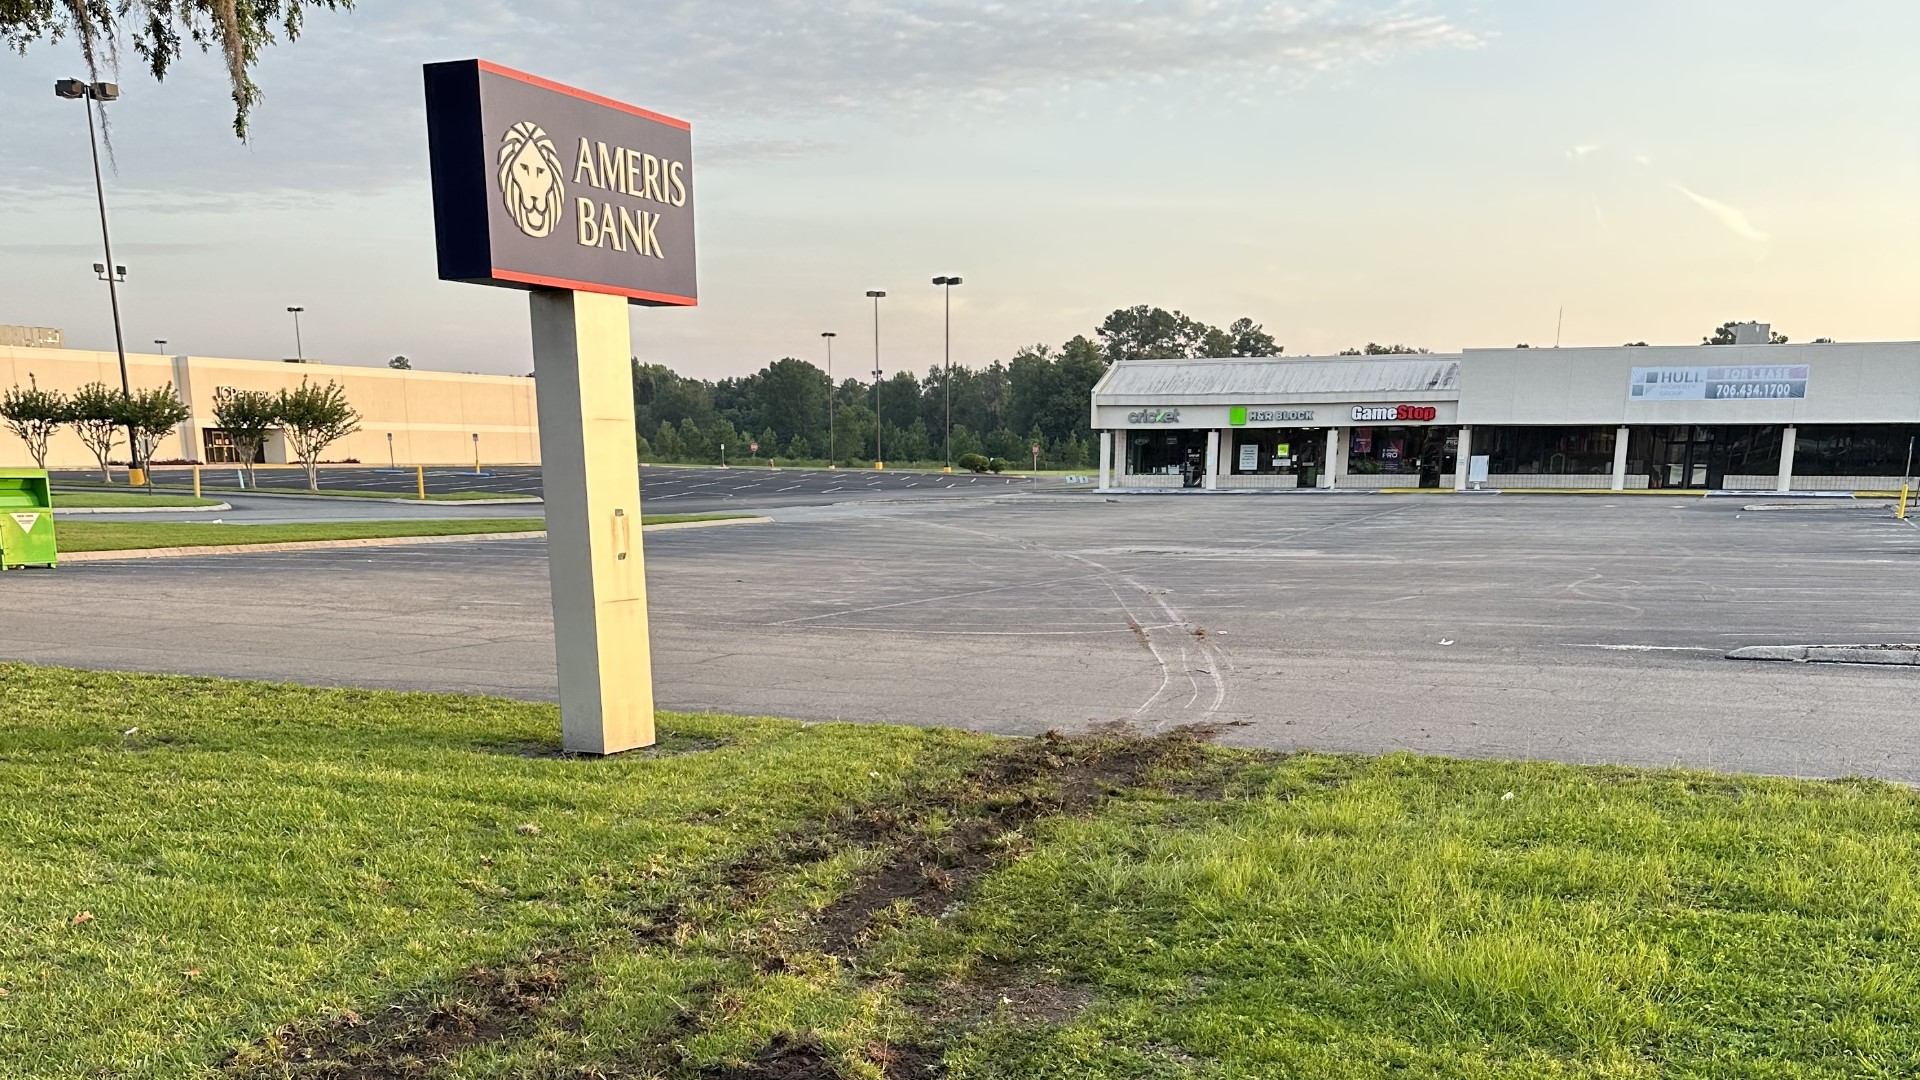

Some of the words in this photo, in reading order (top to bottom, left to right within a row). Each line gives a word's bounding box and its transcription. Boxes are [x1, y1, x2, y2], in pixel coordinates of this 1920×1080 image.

[572, 137, 686, 208] AMERIS
[575, 197, 665, 259] BANK
[1661, 371, 1704, 383] HULL
[1724, 369, 1748, 379] FOR
[1752, 368, 1790, 378] LEASE
[1716, 384, 1791, 396] 706.434.1700
[1128, 408, 1180, 424] cricket
[1249, 411, 1273, 422] H&R
[1275, 410, 1314, 421] BLOCK
[1351, 405, 1436, 421] GameStop
